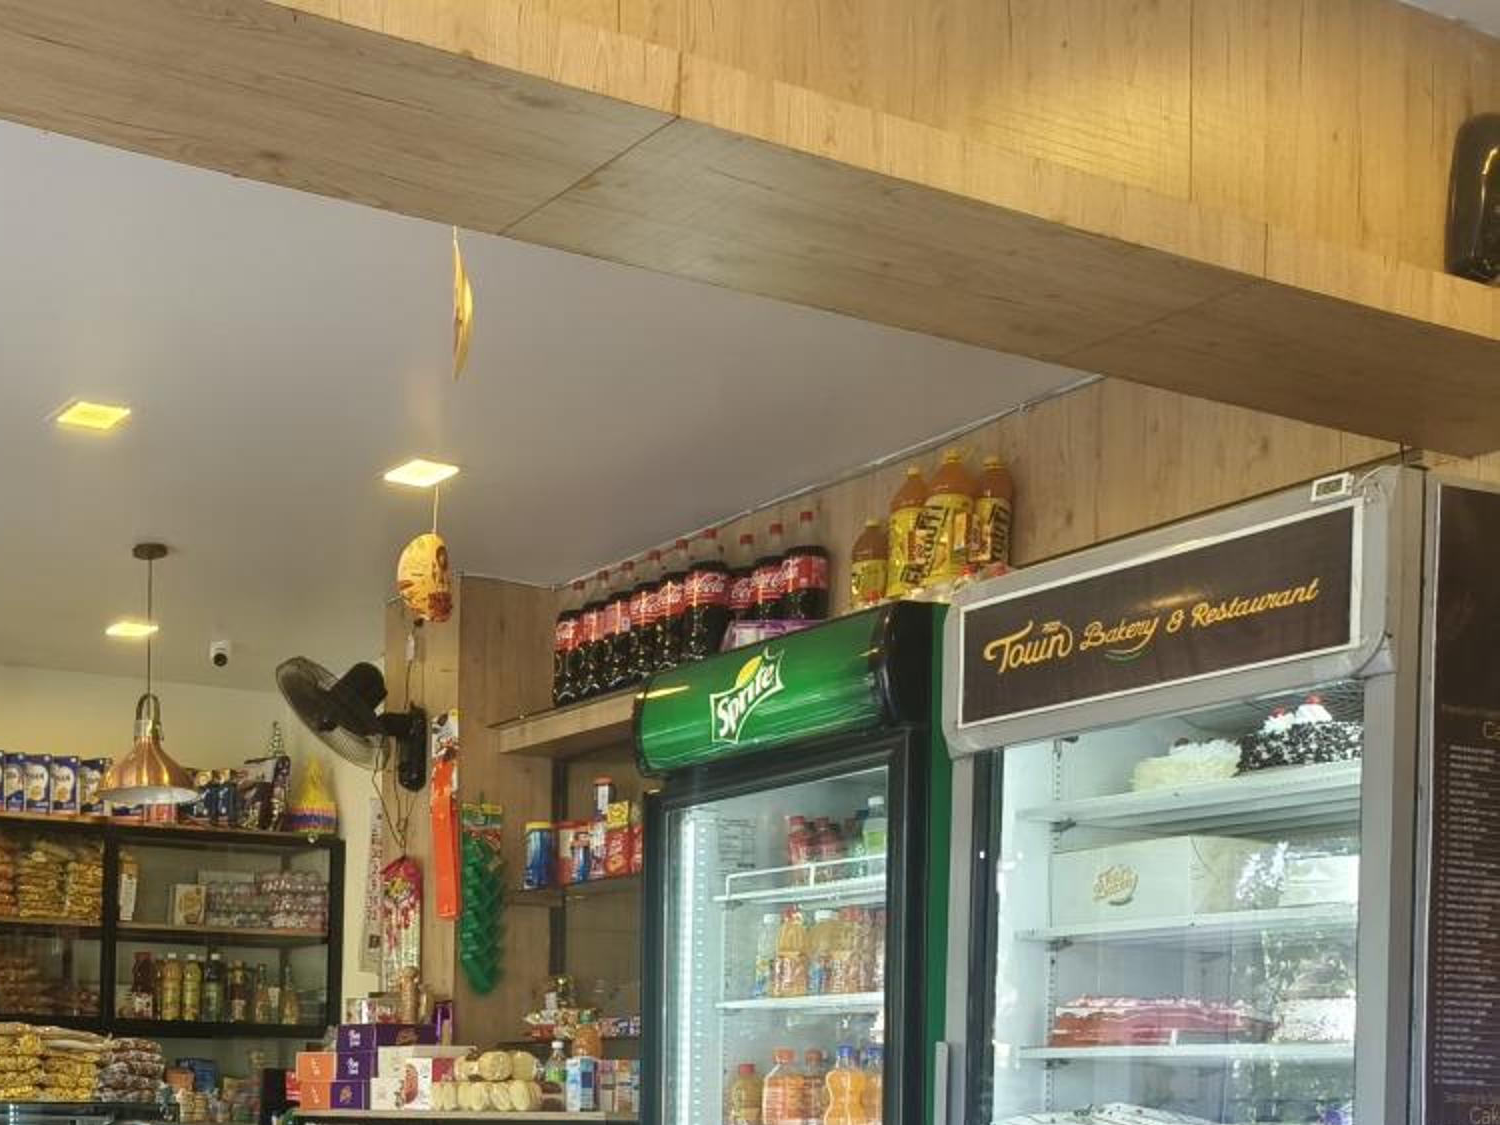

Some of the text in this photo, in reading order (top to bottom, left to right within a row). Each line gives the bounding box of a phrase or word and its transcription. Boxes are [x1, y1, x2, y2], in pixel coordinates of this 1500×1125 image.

[984, 577, 1322, 674] Town Bakery & Restaurant
[716, 664, 776, 738] Sprite
